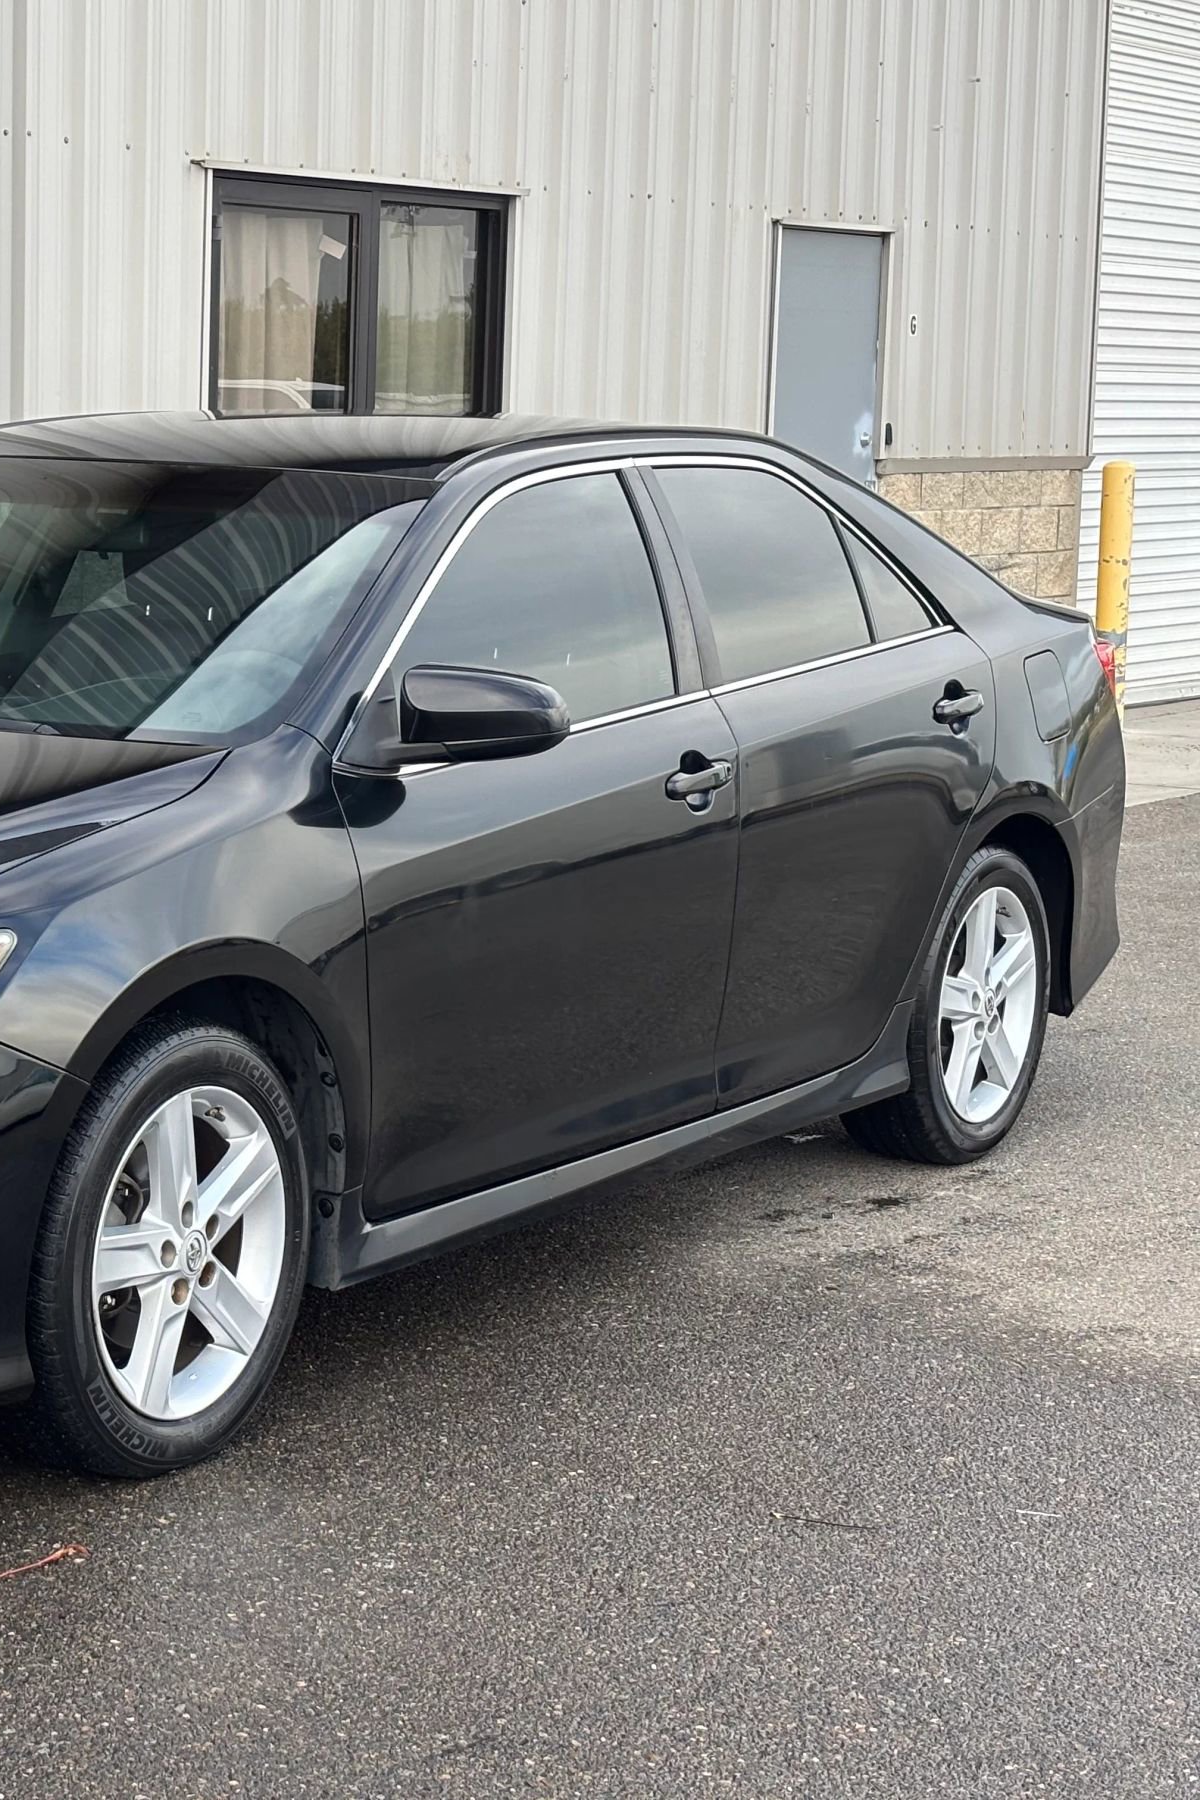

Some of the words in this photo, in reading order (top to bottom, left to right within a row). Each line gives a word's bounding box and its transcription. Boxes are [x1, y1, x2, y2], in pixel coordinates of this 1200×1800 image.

[910, 315, 917, 335] G
[224, 1050, 296, 1132] MICHELIN
[87, 1384, 171, 1459] MICHELIN
